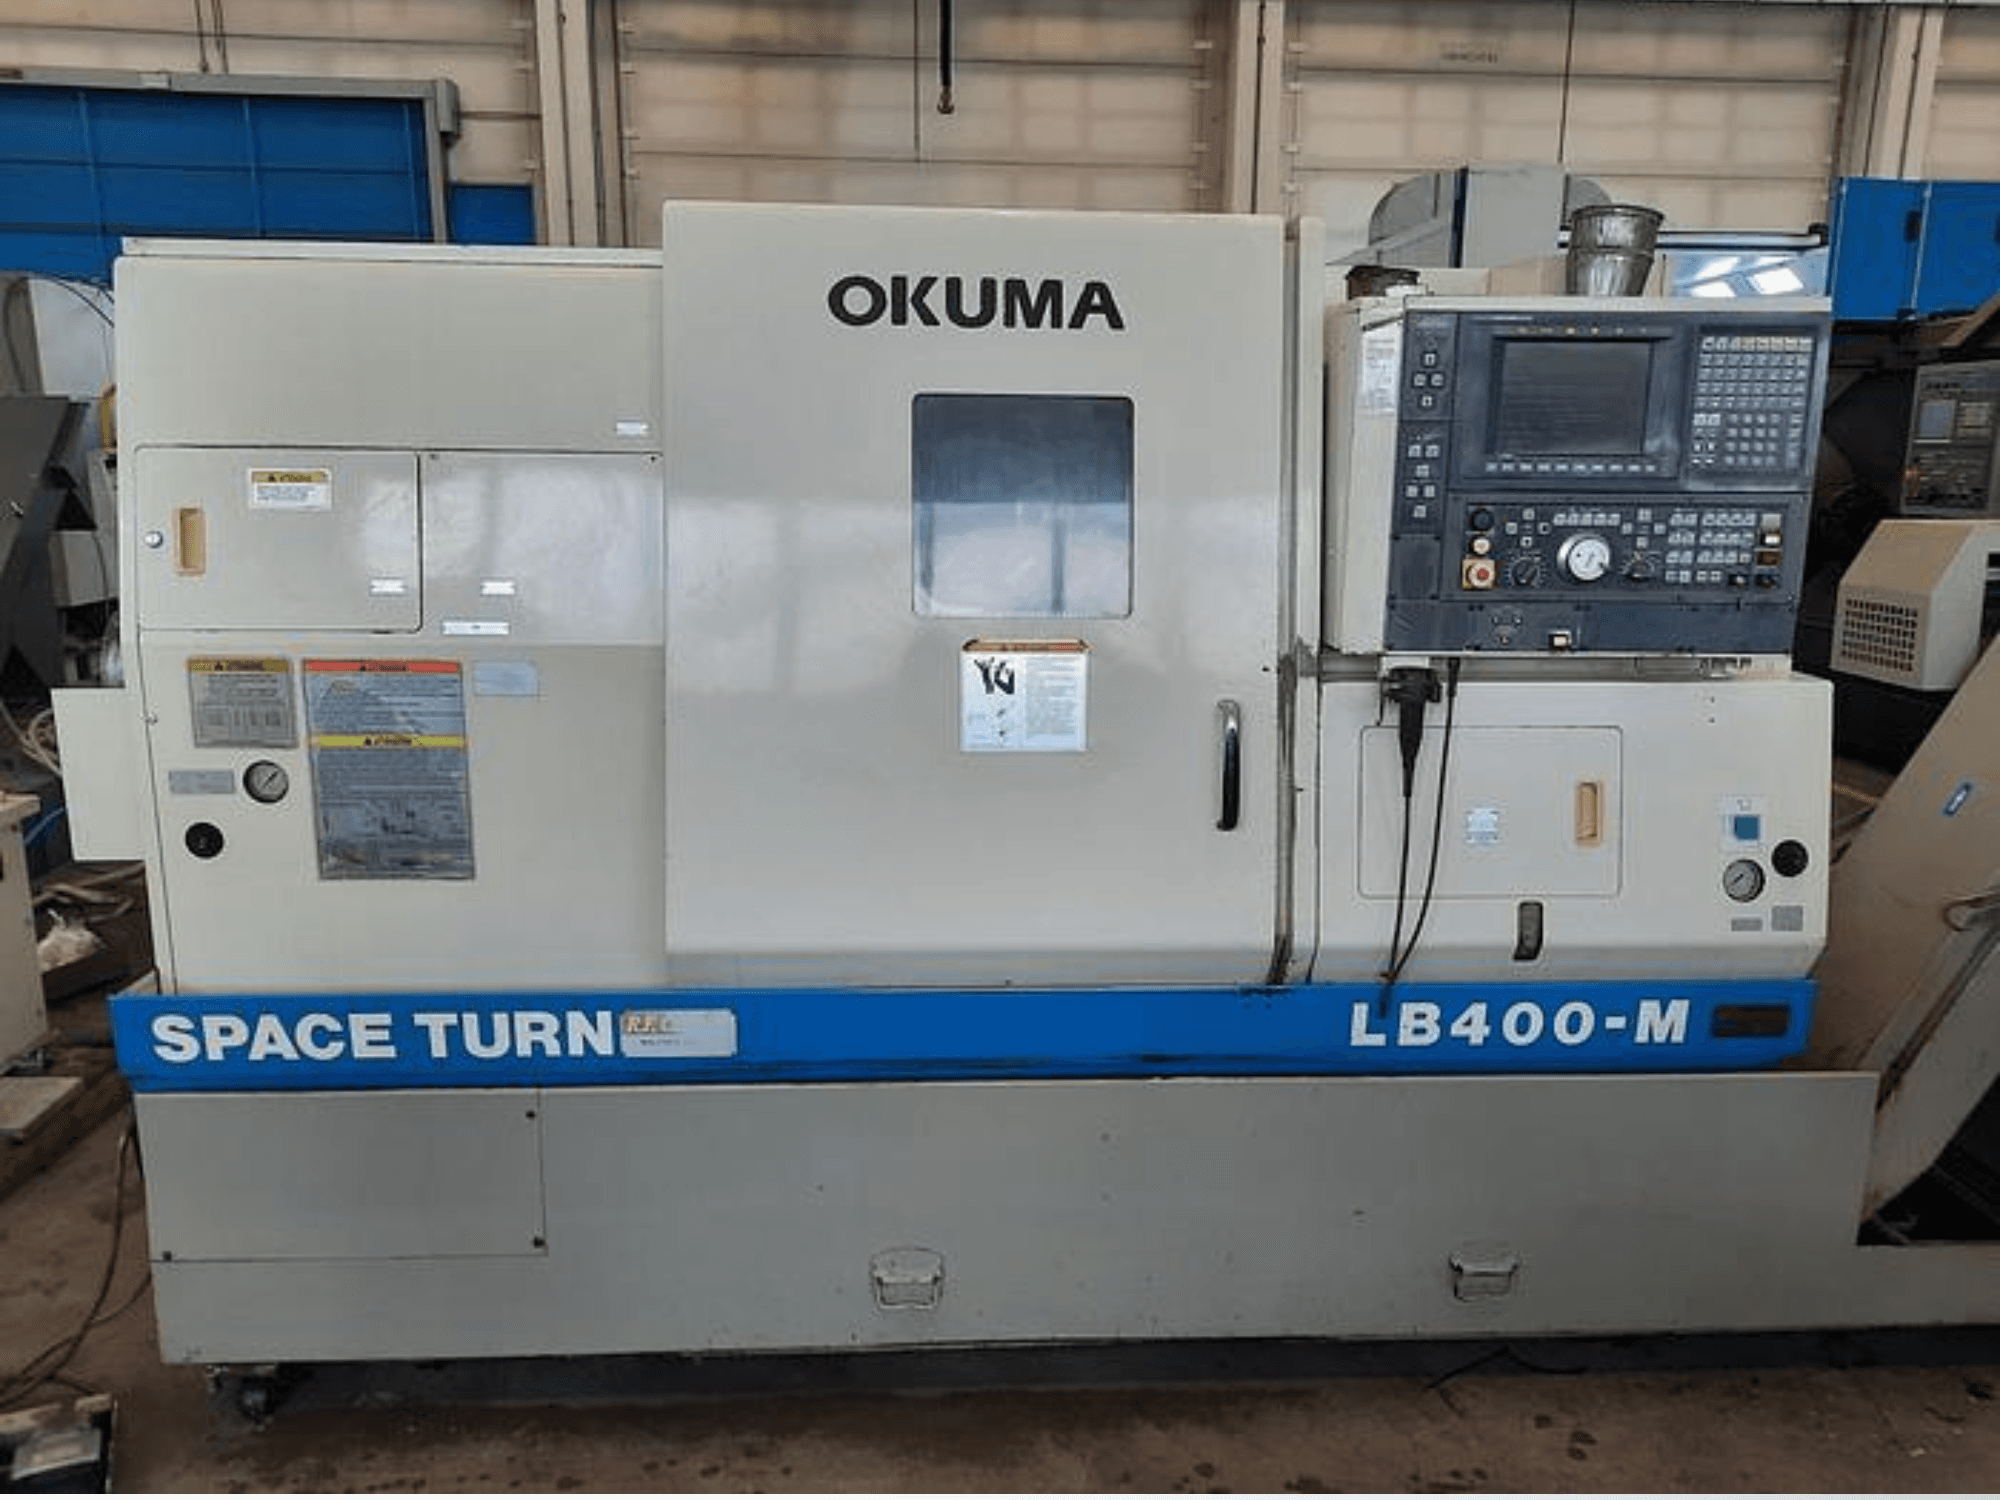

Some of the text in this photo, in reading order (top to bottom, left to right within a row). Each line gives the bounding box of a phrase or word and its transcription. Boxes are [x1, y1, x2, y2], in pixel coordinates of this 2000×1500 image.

[827, 275, 1125, 331] OKUMA
[151, 1013, 397, 1063] SPACE
[413, 1010, 614, 1058] TURN
[1350, 999, 1689, 1046] LB400-M
